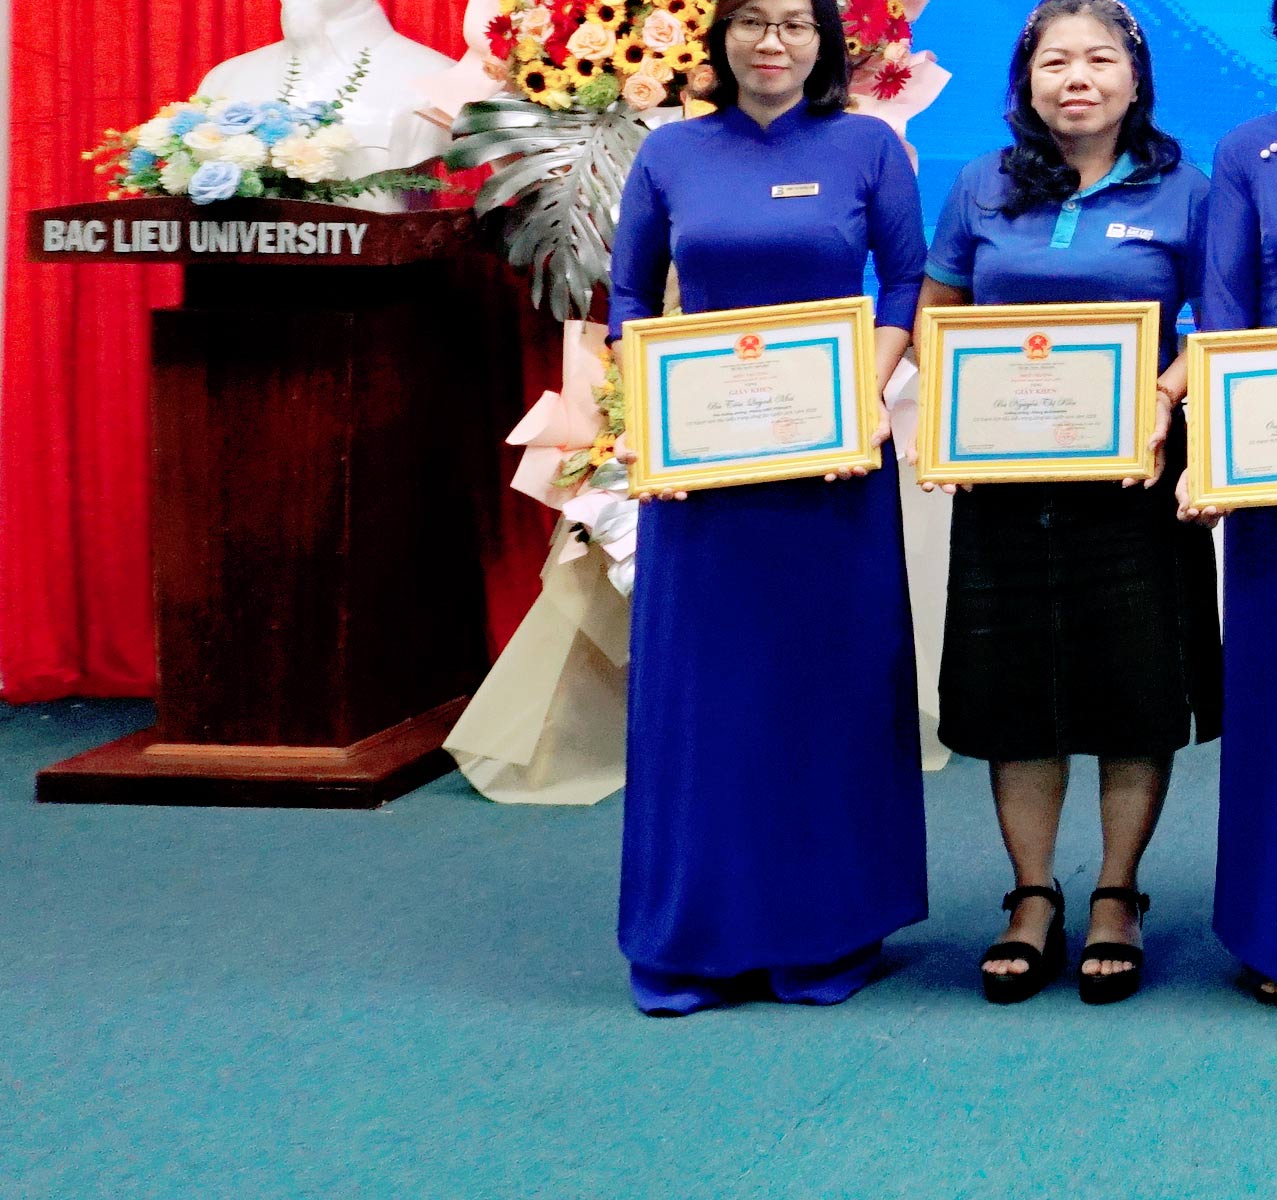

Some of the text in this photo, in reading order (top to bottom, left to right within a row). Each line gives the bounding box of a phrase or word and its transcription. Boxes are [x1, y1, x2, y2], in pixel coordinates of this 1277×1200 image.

[43, 219, 369, 255] BAC LIEU UNIVERSITY
